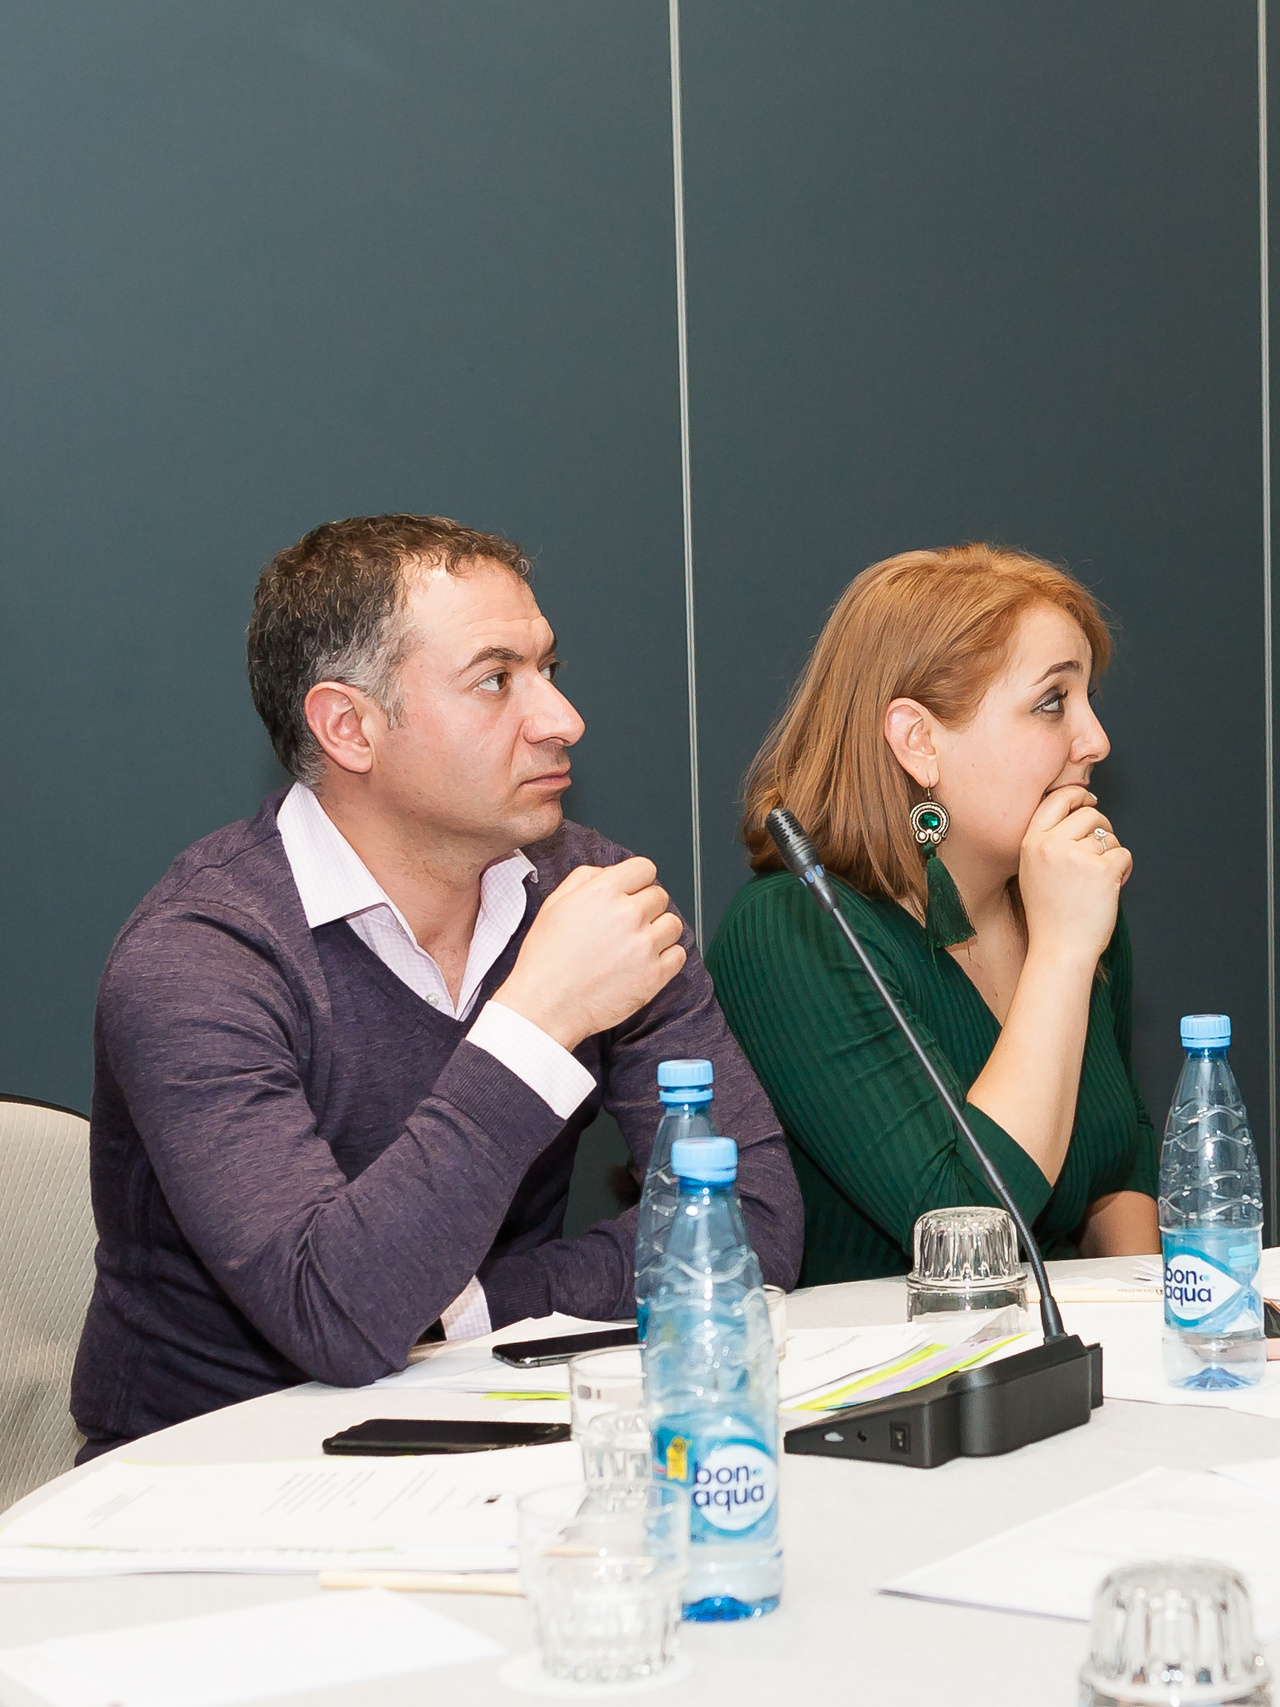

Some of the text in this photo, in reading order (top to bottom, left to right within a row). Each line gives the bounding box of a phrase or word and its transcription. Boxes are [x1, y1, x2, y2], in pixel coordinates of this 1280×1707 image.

[1164, 1262, 1198, 1285] bon
[1165, 1284, 1212, 1307] aqua
[693, 1461, 751, 1485] bon
[693, 1484, 765, 1512] aqua
